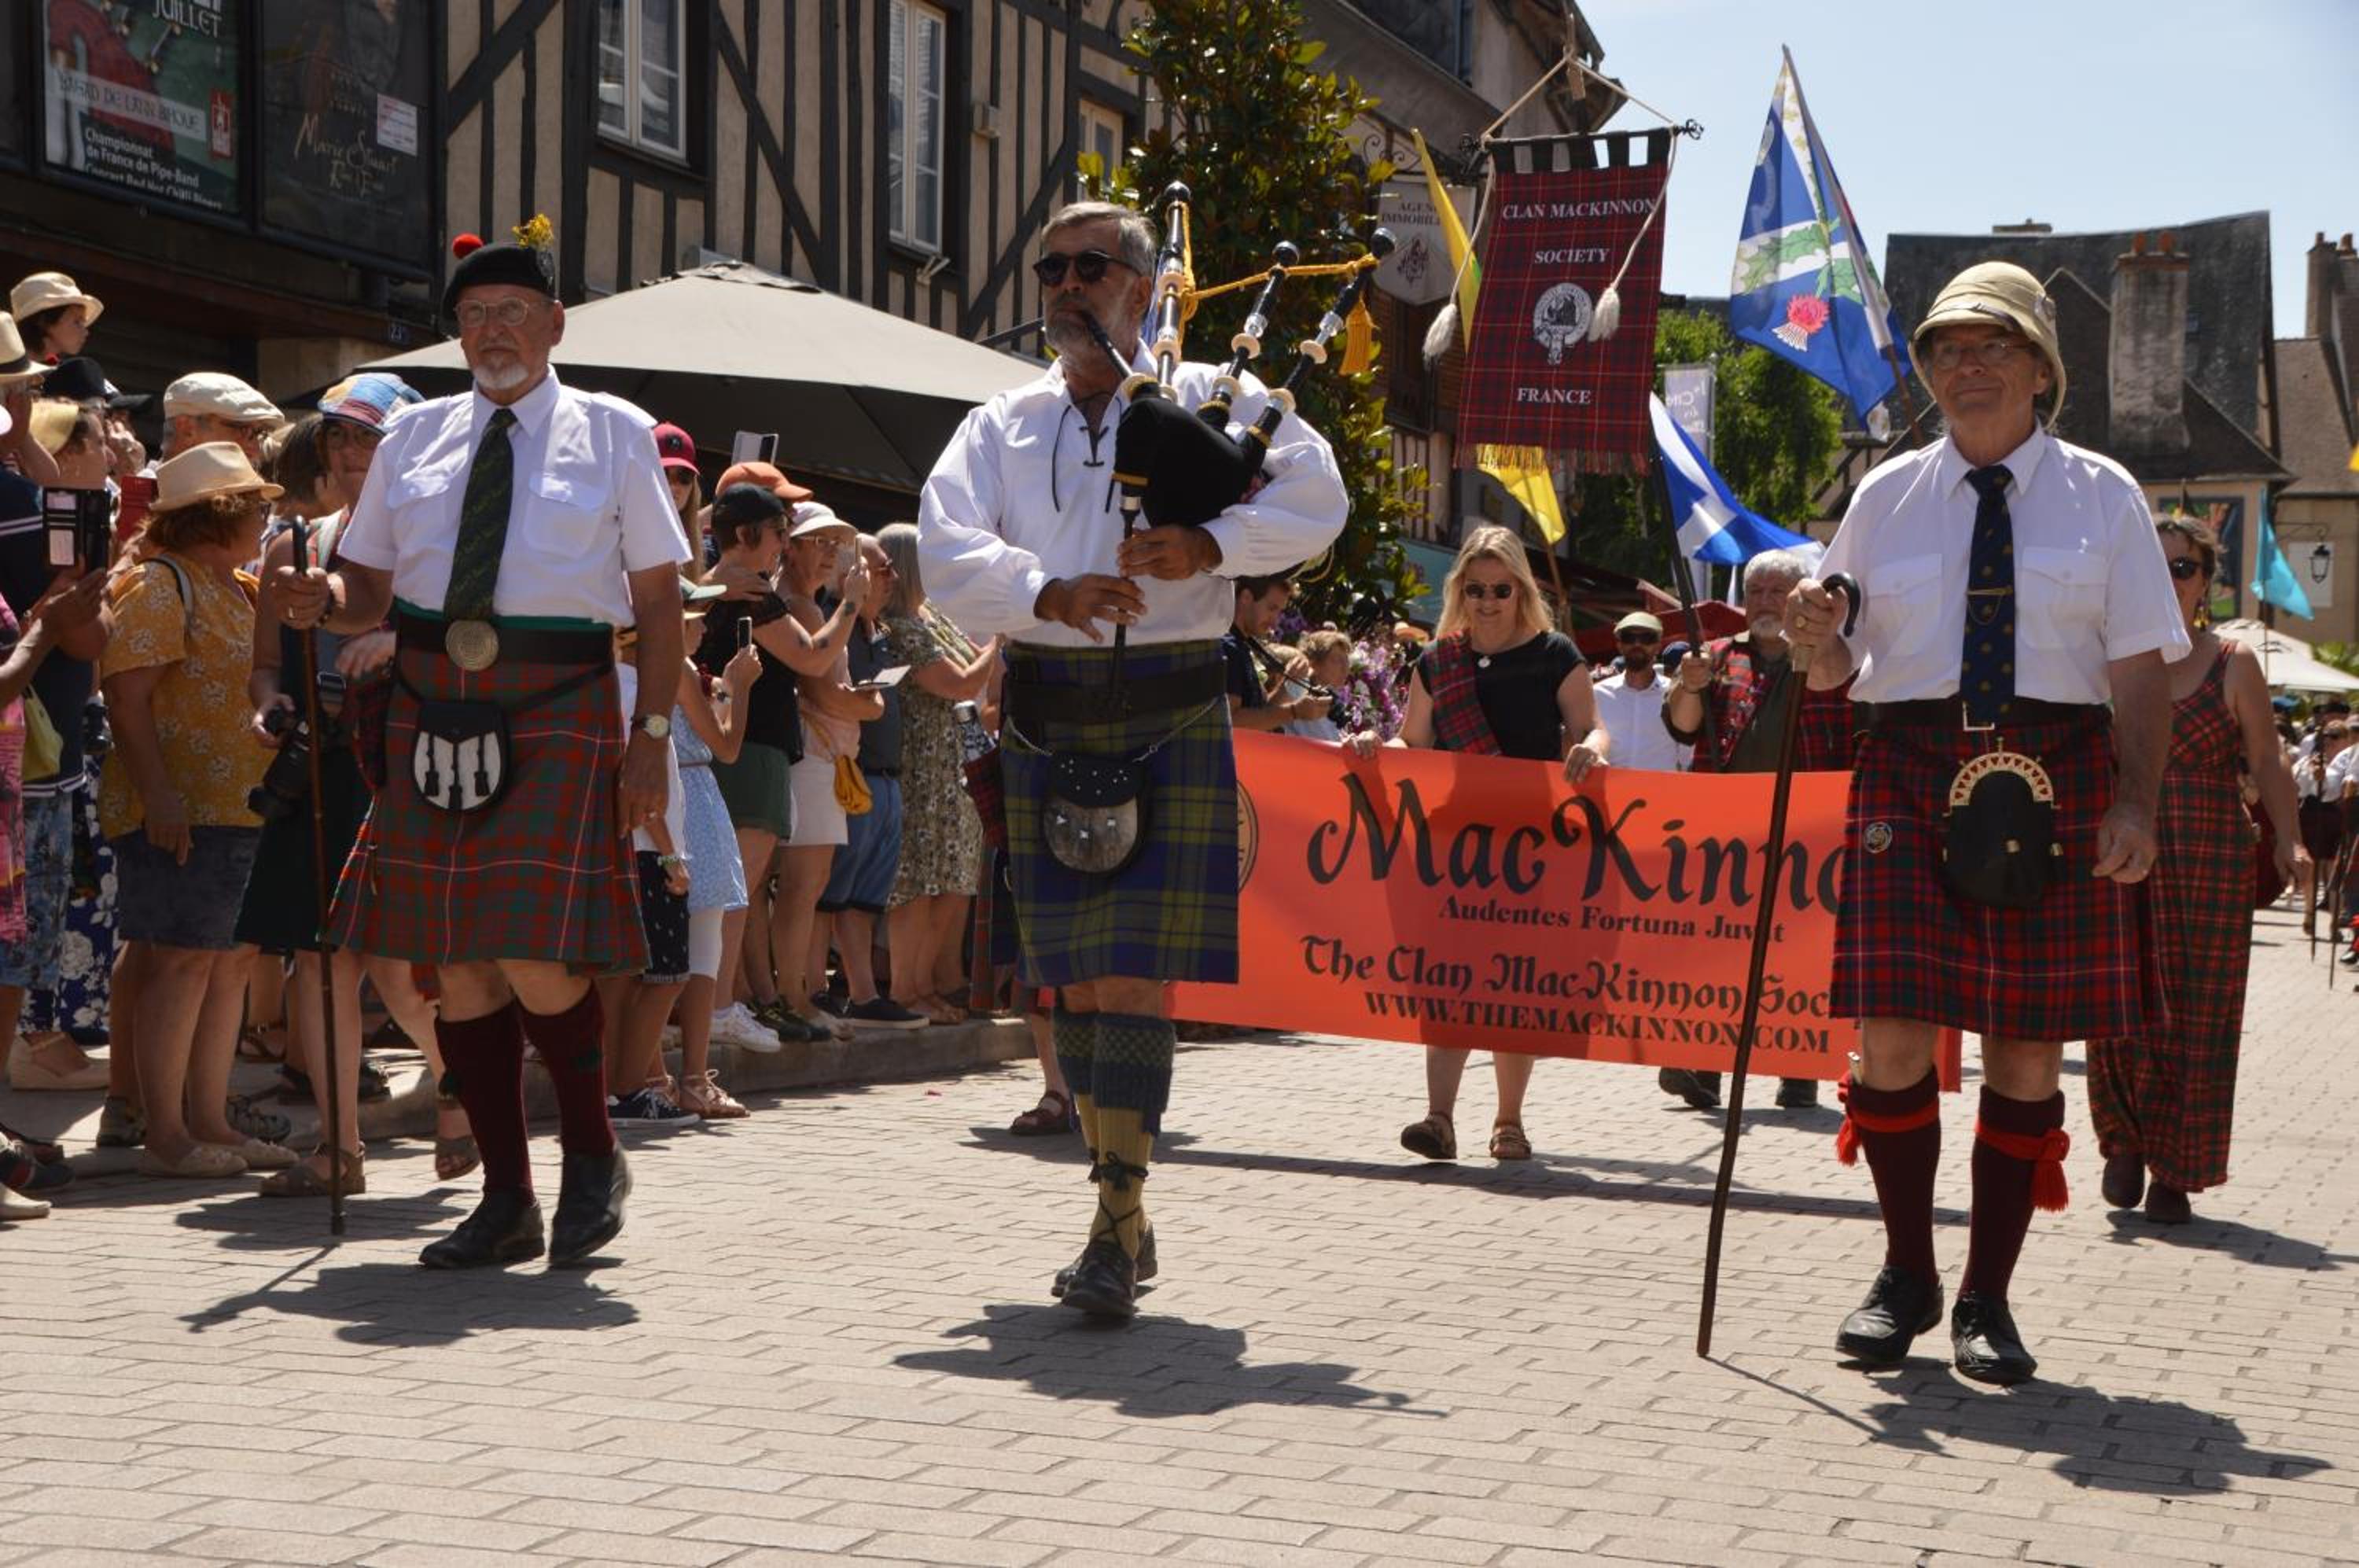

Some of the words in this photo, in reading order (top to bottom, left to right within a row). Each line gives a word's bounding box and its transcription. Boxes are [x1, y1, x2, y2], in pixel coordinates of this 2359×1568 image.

[153, 0, 222, 38] JUILLET
[84, 127, 153, 158] Championnat
[101, 148, 134, 168] France
[150, 160, 200, 188] Pipe-Band
[1397, 201, 1437, 213] AGEN
[1503, 204, 1546, 219] CLAN
[1549, 198, 1657, 219] MACKINNON
[1534, 248, 1610, 264] SOCIETY
[1517, 387, 1592, 404] FRANCE
[1307, 771, 1848, 915] MacKinno
[1438, 895, 1570, 927] Audentes
[1581, 905, 1696, 937] Fortuna
[1705, 915, 1785, 943] Juvt
[1300, 935, 1375, 983] The
[1386, 945, 1474, 996] Clan
[1482, 953, 1743, 1018] MacKinnon
[1757, 974, 1830, 1015] Soc
[1364, 991, 1831, 1054] WWW.THEMACKINNONCOM
